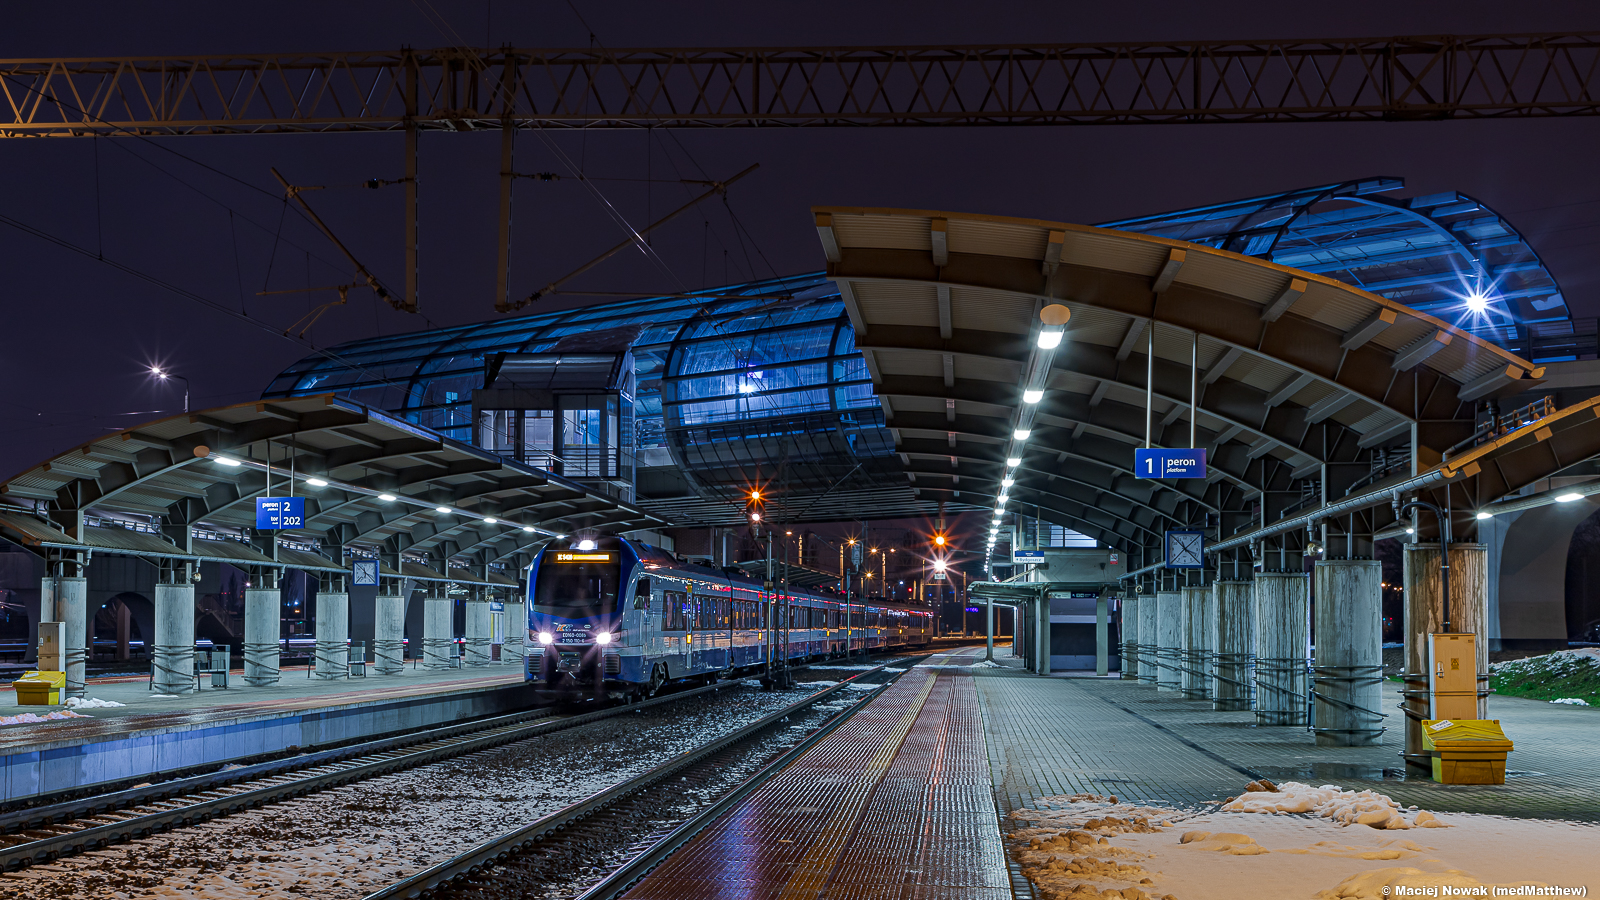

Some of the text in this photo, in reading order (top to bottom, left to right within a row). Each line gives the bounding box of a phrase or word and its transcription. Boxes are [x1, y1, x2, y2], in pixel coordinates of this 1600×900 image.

[1145, 458, 1195, 473] 1 peron
[283, 502, 290, 511] 2
[283, 516, 300, 525] 202
